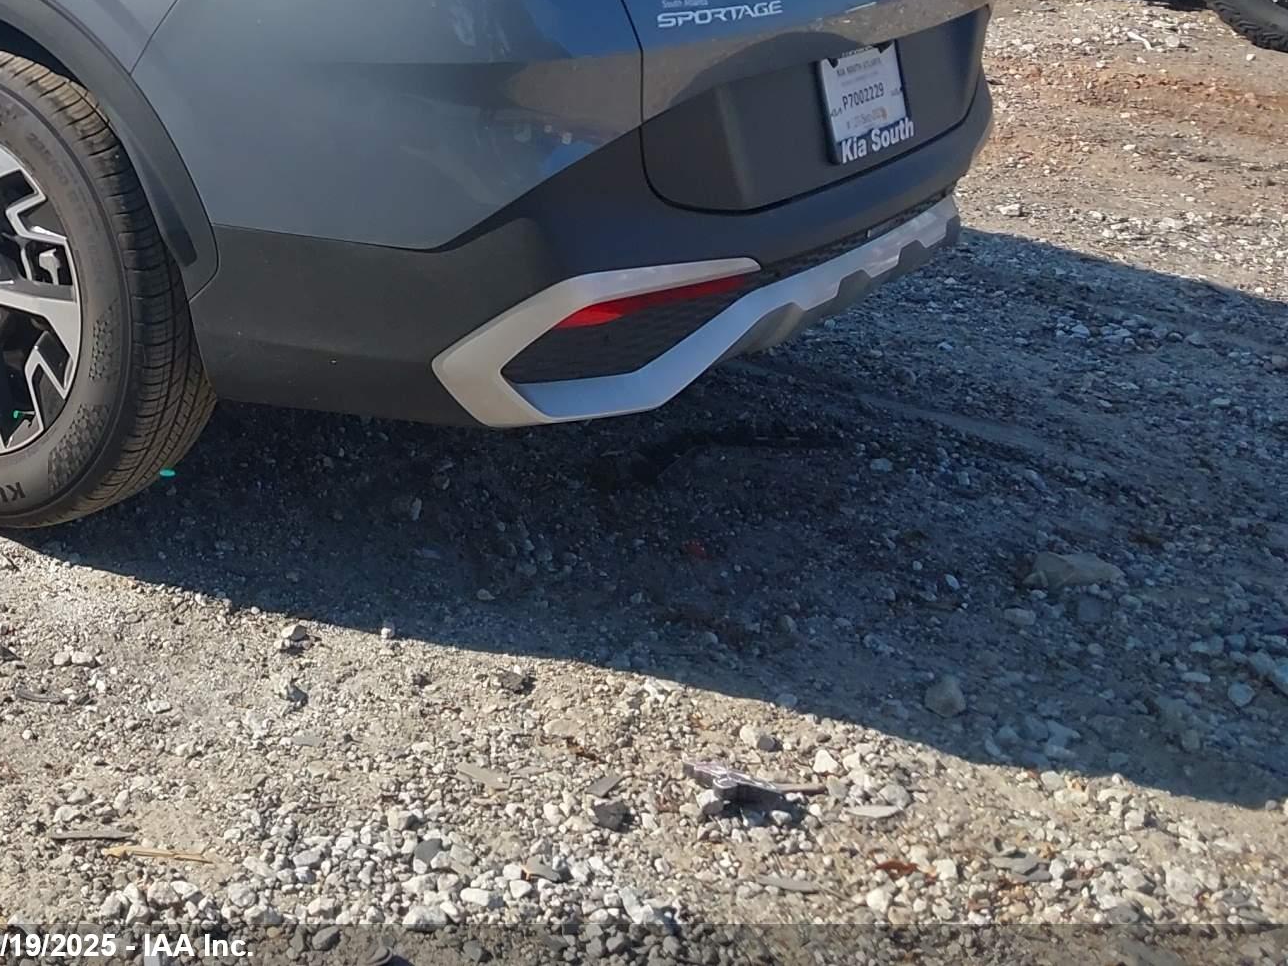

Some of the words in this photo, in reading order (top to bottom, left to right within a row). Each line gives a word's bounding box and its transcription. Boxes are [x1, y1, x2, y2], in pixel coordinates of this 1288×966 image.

[657, 0, 783, 27] SPORTAGE
[842, 82, 884, 111] P7002229
[841, 136, 867, 164] Kia
[871, 117, 914, 152] South
